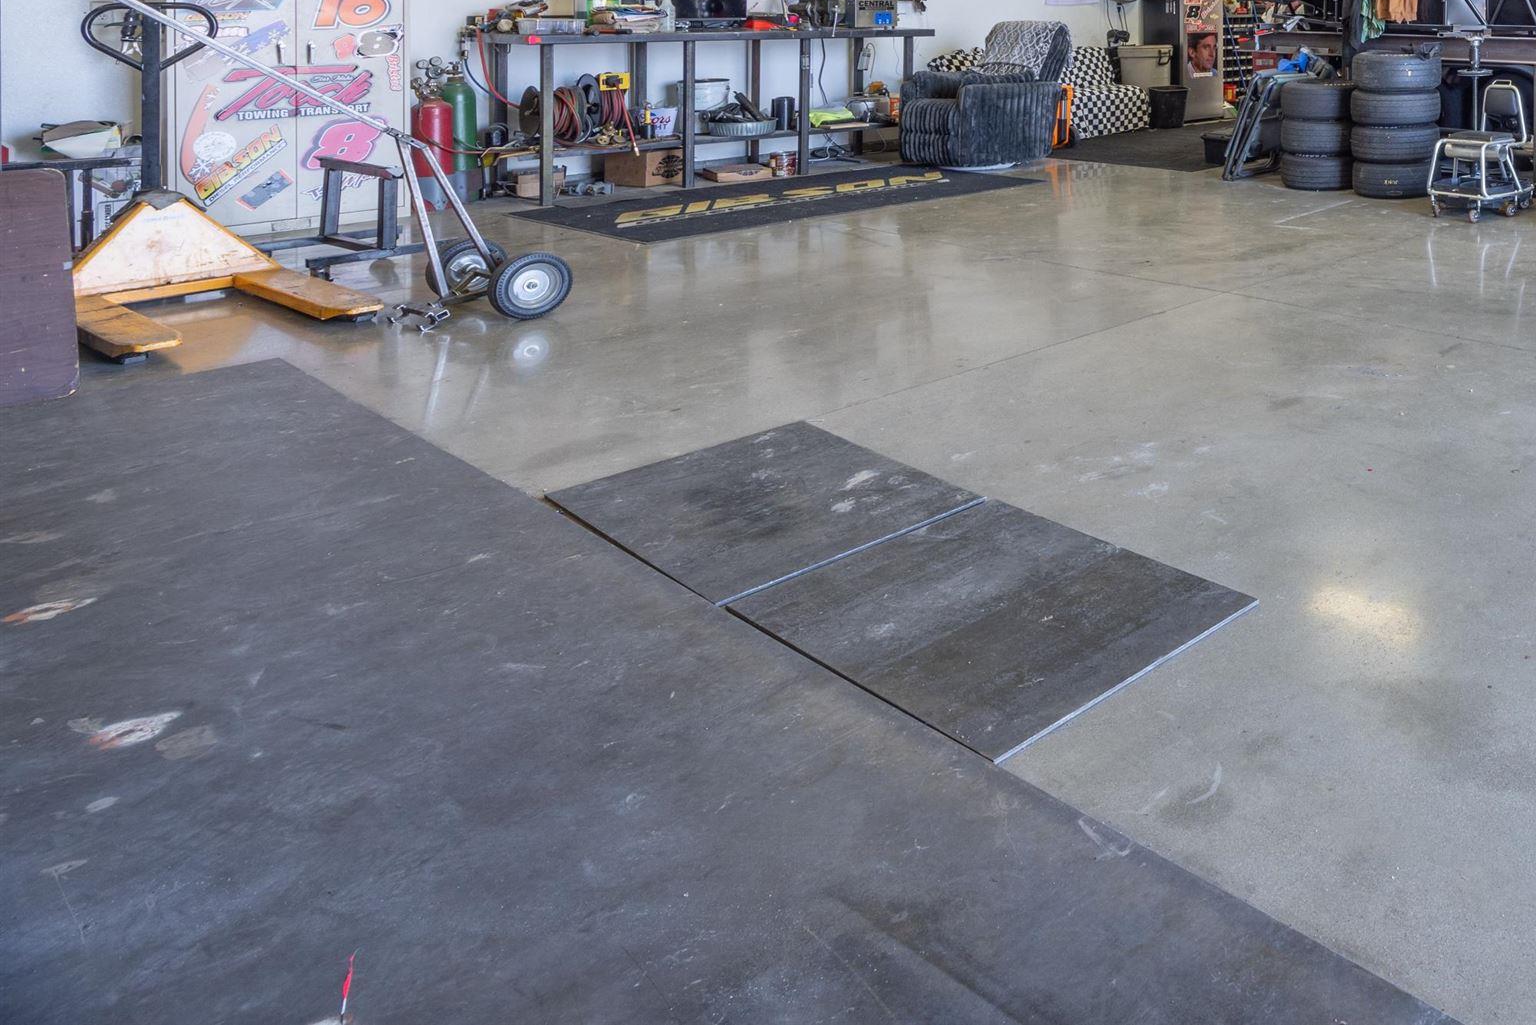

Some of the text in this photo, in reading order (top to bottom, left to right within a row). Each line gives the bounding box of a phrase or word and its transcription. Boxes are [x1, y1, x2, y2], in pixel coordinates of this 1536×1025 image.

[237, 108, 289, 121] TOWING
[300, 116, 387, 171] 8
[614, 170, 943, 223] GIBSON
